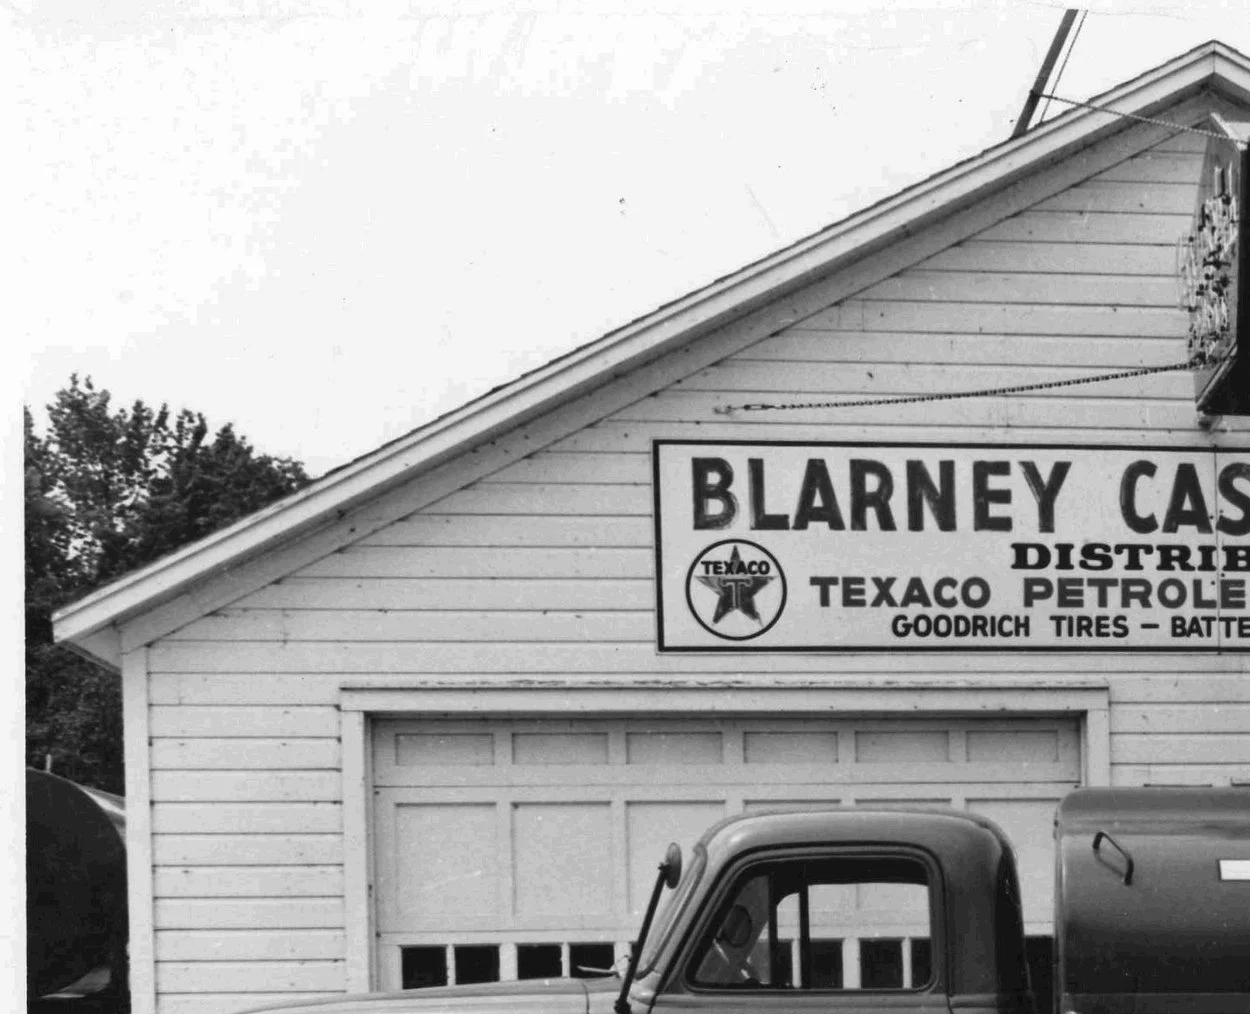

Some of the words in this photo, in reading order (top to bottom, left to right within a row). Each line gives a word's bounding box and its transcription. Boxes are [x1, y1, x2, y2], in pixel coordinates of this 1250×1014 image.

[691, 456, 1072, 534] BLARNEY
[700, 560, 771, 575] TEXACO
[809, 576, 991, 608] TEXACO
[891, 613, 1030, 638] GOODRICH
[1049, 614, 1130, 639] TIRES
